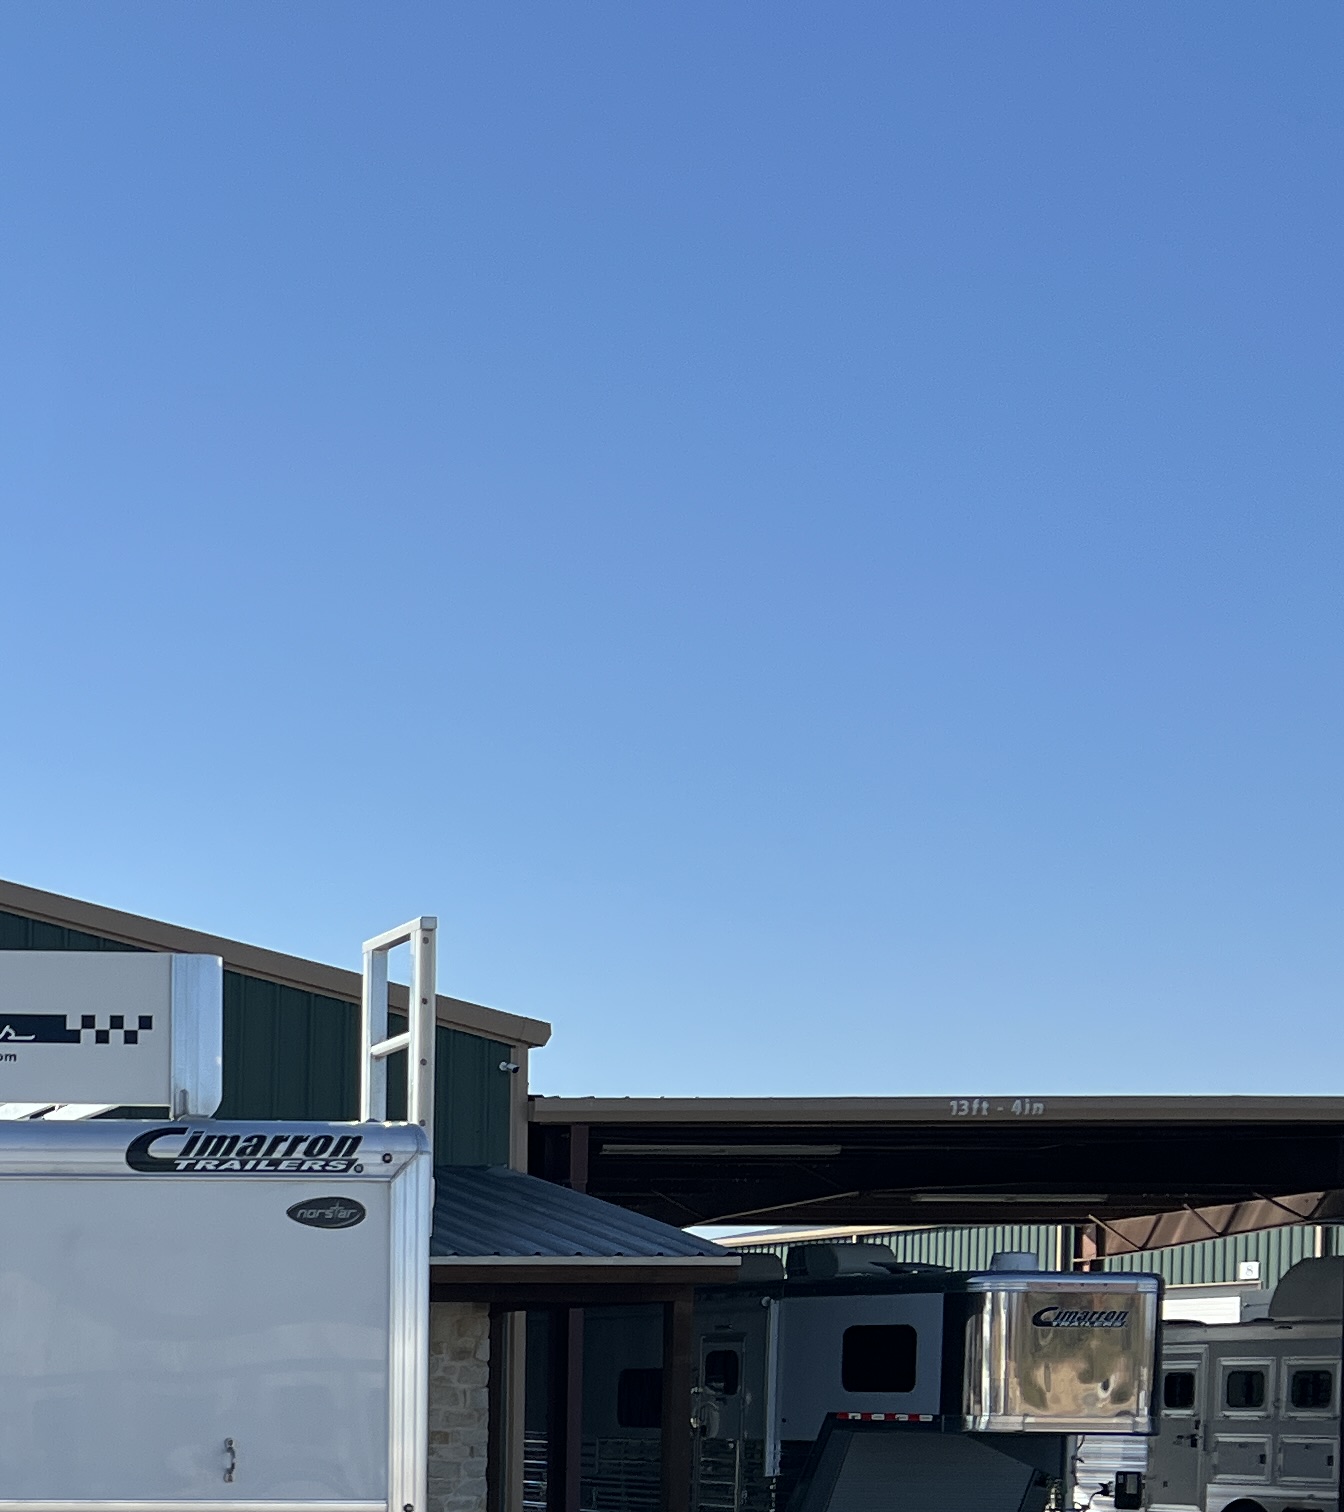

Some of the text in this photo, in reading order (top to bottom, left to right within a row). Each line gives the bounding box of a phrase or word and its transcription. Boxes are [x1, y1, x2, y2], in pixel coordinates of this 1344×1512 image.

[949, 1098, 990, 1116] 13ft
[1010, 1098, 1045, 1116] 4in
[125, 1126, 364, 1173] Cimarron
[172, 1159, 350, 1172] TRAILERS
[295, 1200, 358, 1220] norstar
[1245, 1264, 1254, 1277] 8
[1032, 1306, 1130, 1327] Cimarron
